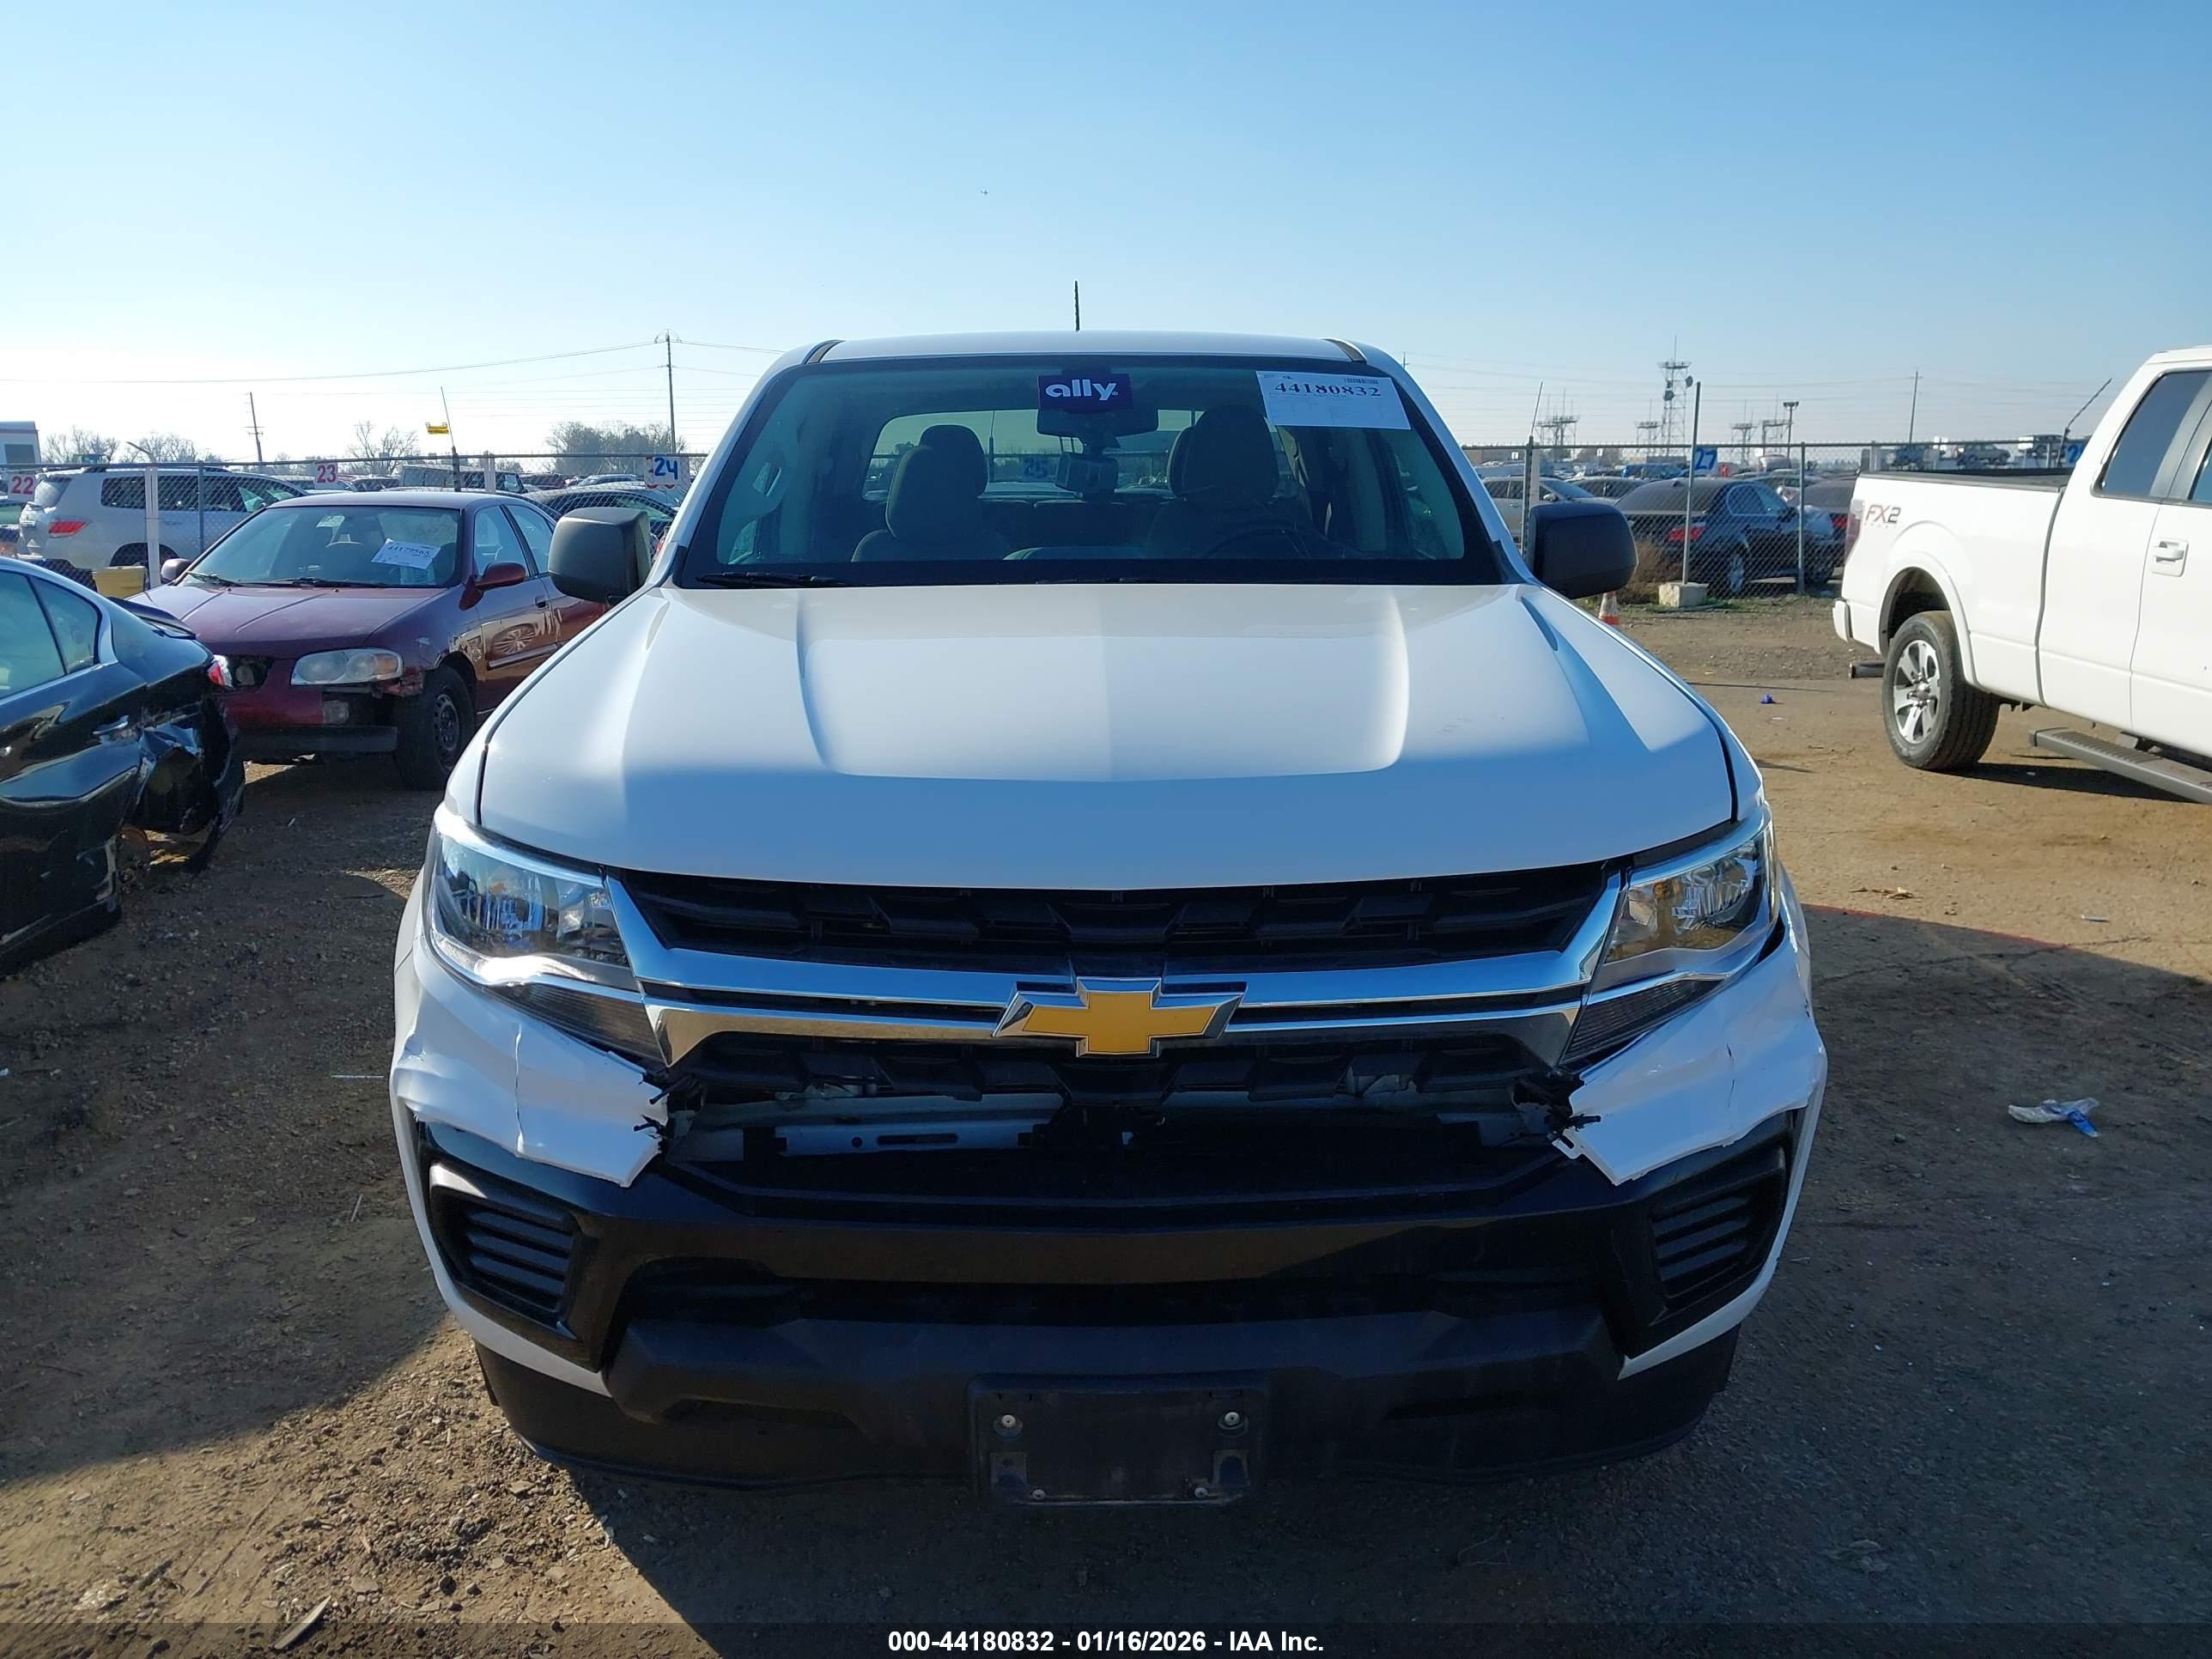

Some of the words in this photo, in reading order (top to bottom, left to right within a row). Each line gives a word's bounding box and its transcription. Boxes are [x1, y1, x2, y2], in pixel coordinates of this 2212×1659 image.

[1274, 382, 1382, 397] 44180832
[654, 457, 678, 480] 24
[1695, 447, 1717, 471] 27
[316, 464, 337, 483] 23
[10, 475, 33, 495] 22
[1865, 504, 1901, 523] FX2
